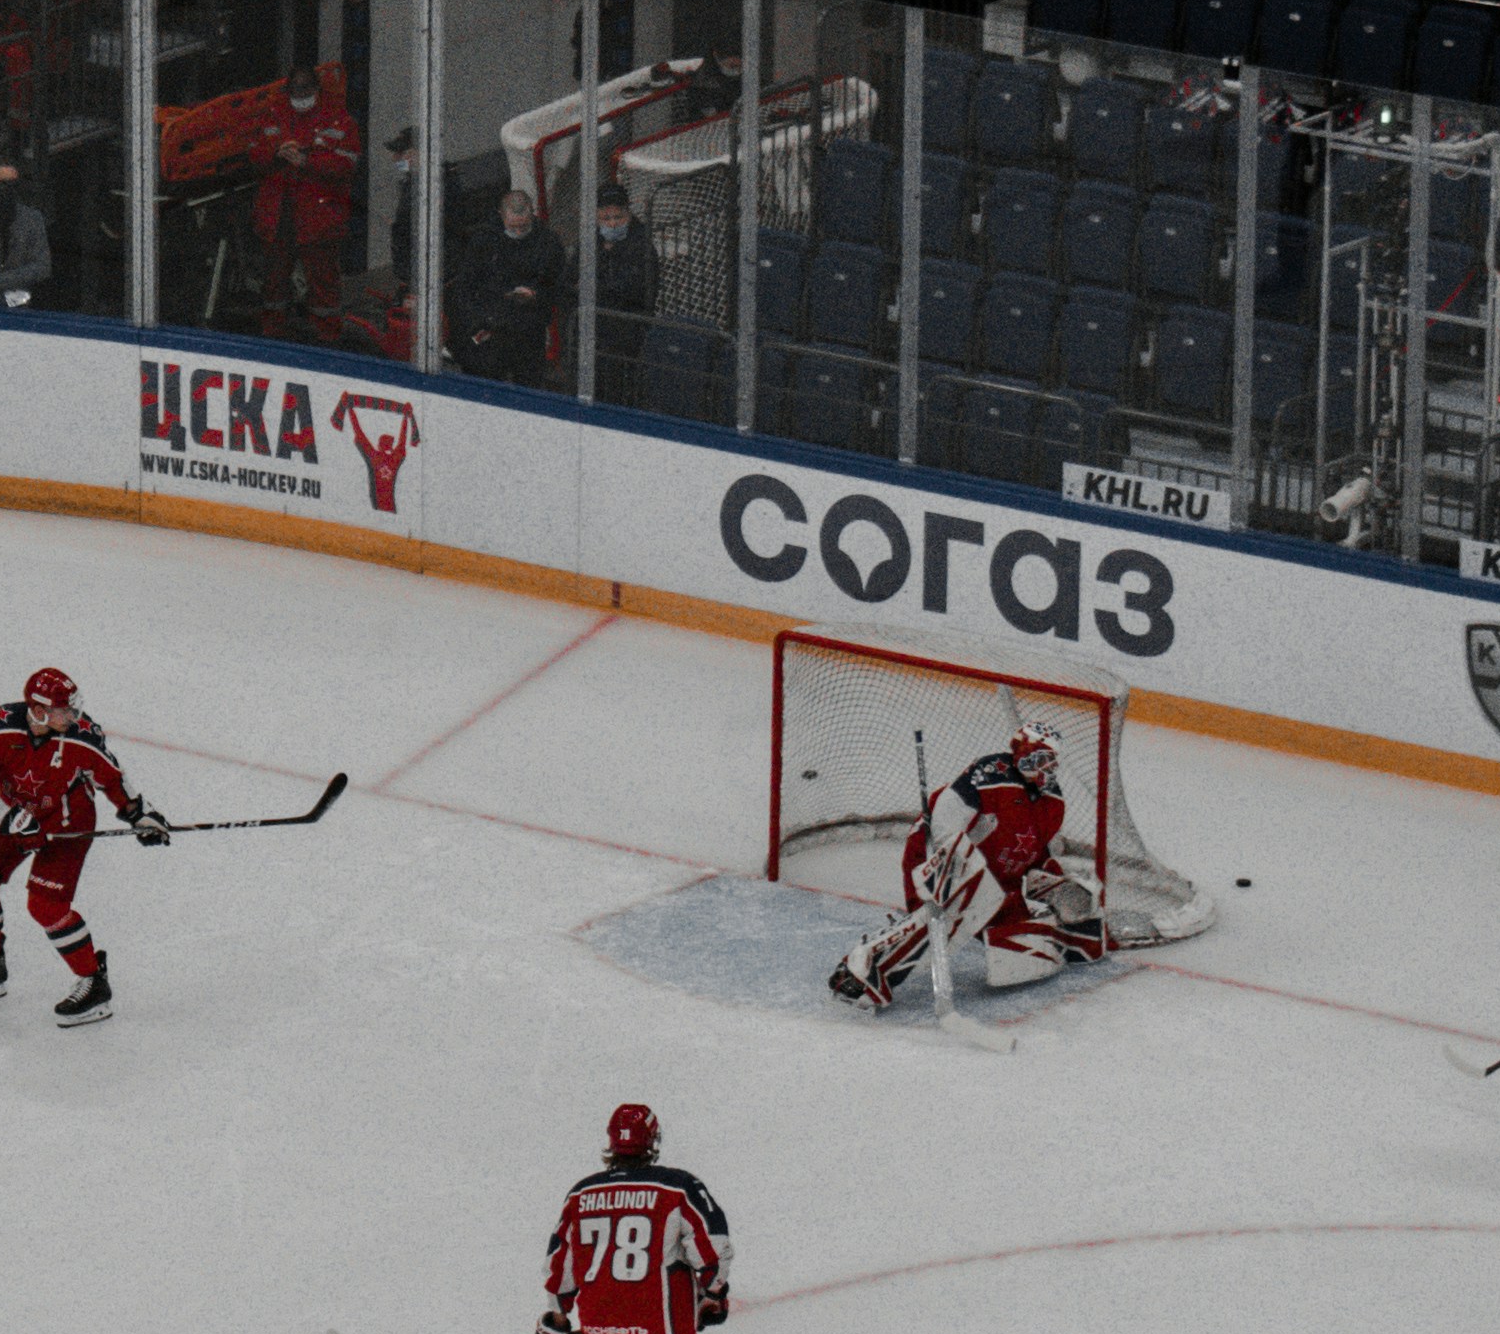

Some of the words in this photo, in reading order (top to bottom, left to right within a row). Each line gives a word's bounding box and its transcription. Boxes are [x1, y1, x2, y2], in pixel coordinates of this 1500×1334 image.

[140, 360, 320, 465] ЦСКА
[140, 452, 323, 501] WWW.CSKA-HOCKEY.RU
[1082, 471, 1210, 522] KHL.RU
[578, 1189, 660, 1214] SHALUNOV
[578, 1214, 654, 1285] 78
